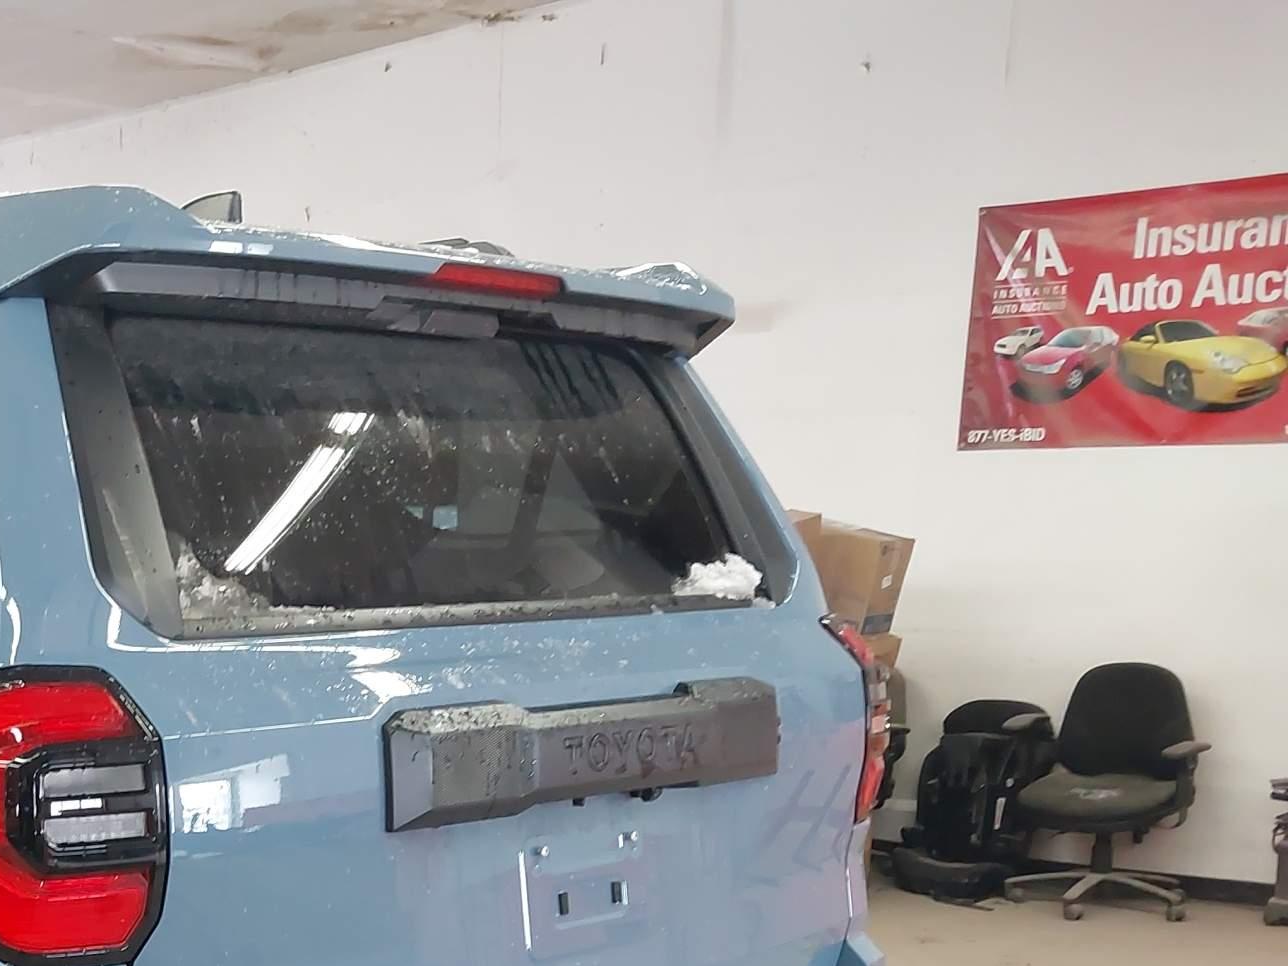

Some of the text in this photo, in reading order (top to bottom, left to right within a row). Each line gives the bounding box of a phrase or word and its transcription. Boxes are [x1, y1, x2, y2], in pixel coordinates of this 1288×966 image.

[1133, 213, 1288, 260] Insuran
[992, 300, 1067, 315] AUTO AUCTI
[1085, 271, 1184, 316] Auto
[563, 722, 700, 775] TOYOTA
